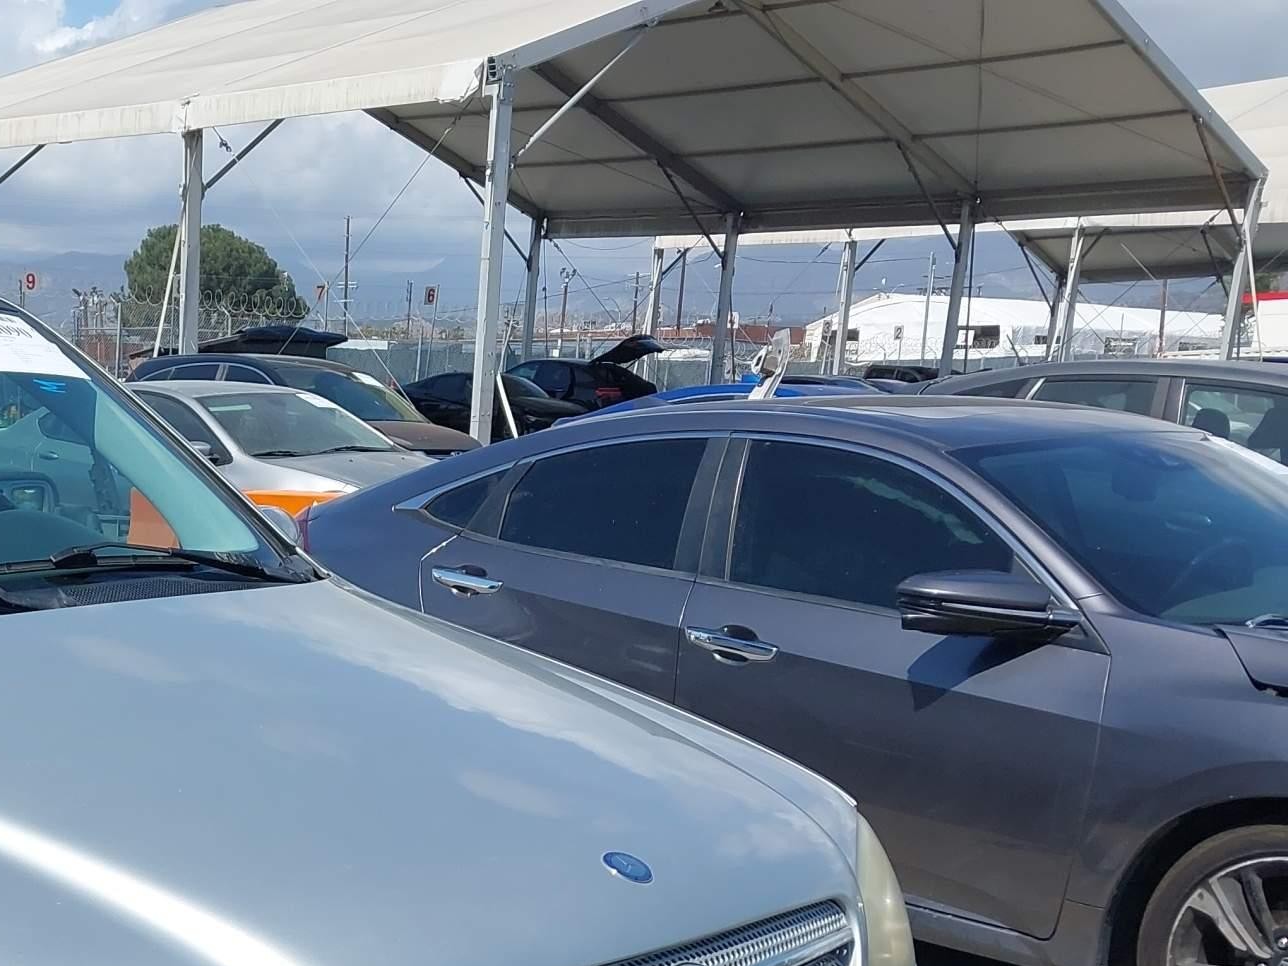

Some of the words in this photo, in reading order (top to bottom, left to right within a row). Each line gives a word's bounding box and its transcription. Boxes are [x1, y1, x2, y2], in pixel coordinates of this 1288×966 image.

[26, 273, 36, 291] 9
[316, 285, 326, 301] 7
[427, 288, 436, 303] 6
[823, 321, 831, 334] 3
[894, 327, 903, 340] 2
